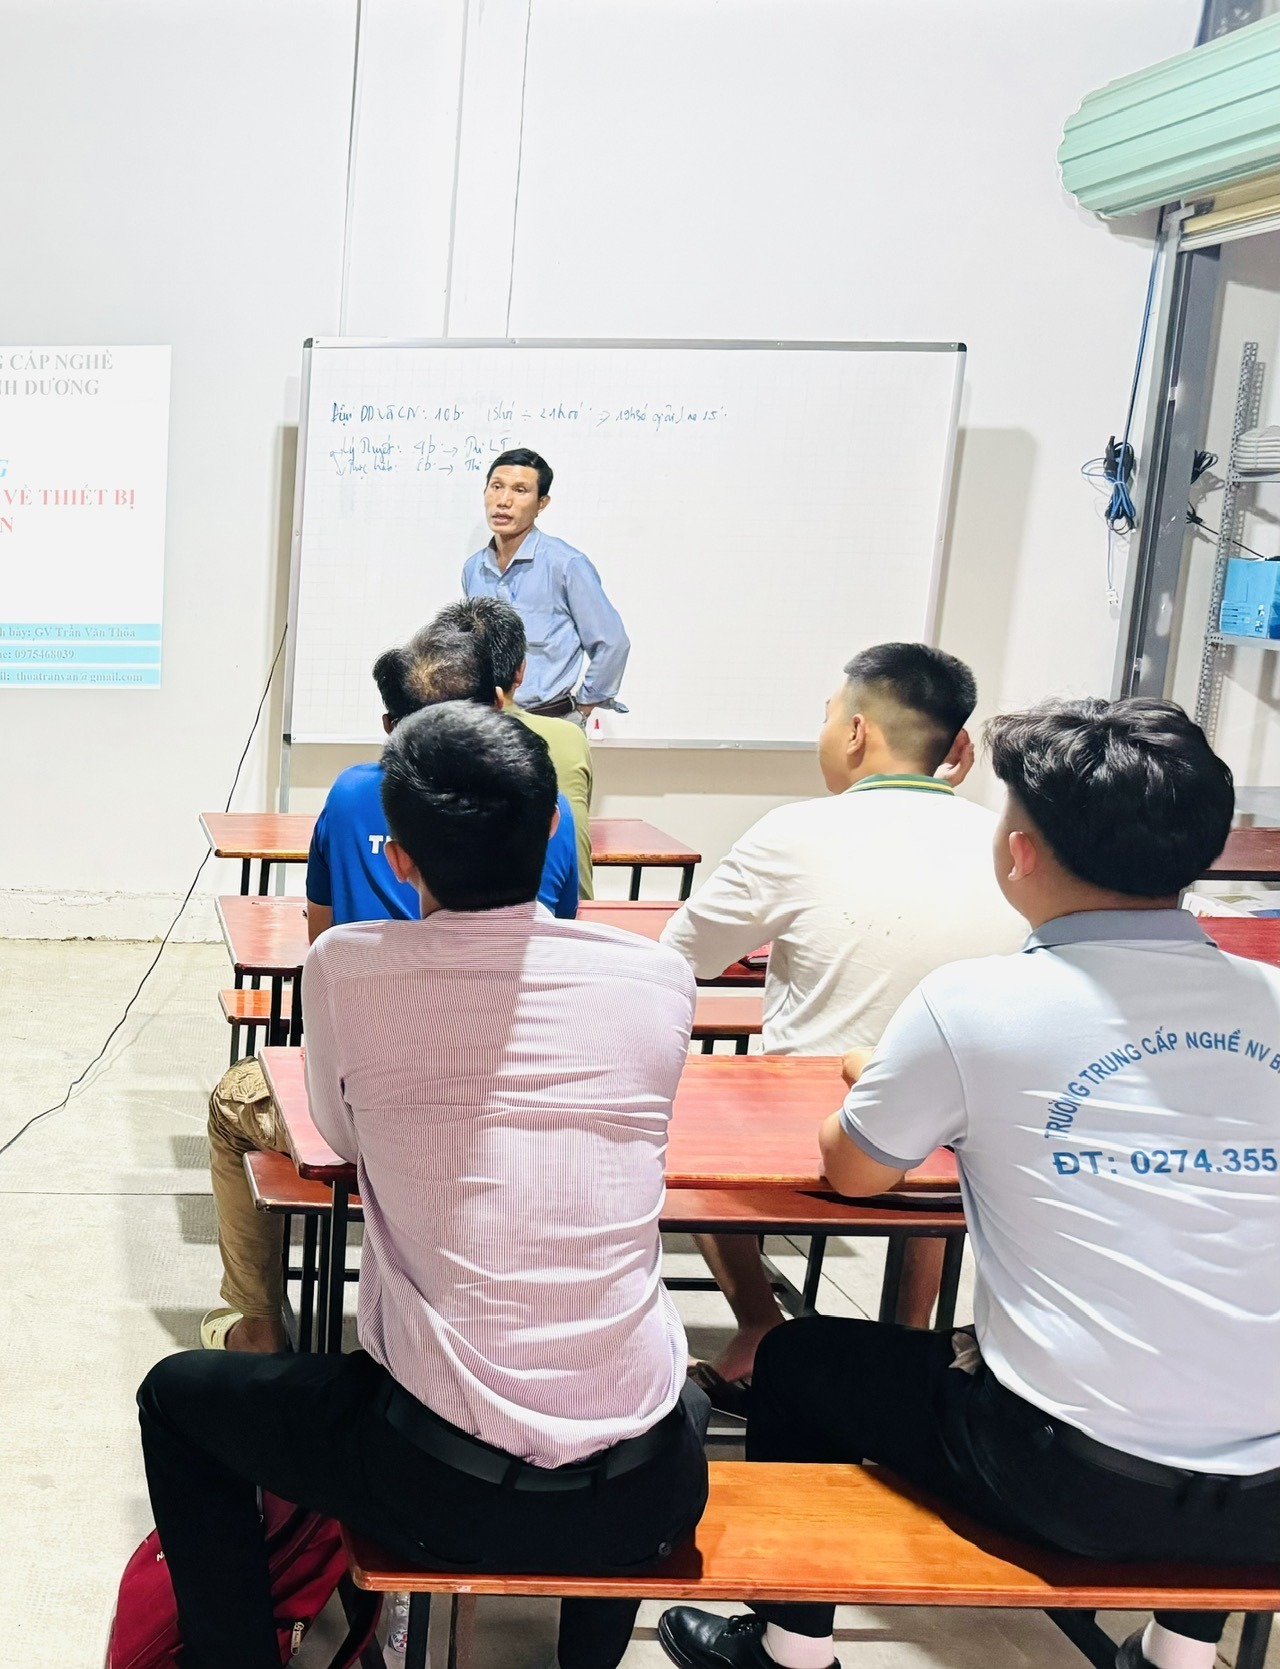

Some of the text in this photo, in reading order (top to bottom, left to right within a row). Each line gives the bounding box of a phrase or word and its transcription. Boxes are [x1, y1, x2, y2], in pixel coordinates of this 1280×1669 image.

[25, 376, 99, 396] DƯƠNG
[113, 487, 135, 511] BỊ
[34, 626, 52, 638] GV
[16, 671, 144, 683] thoatranvan@gmail.com
[368, 834, 392, 854] T
[1078, 1042, 1143, 1085] TRUNG
[1141, 1025, 1178, 1057] CẤP
[1185, 1028, 1242, 1053] NGHỀ
[1244, 1039, 1271, 1062] NV
[1269, 1053, 1280, 1074] B
[1052, 1148, 1278, 1176] ĐT: 0274.355
